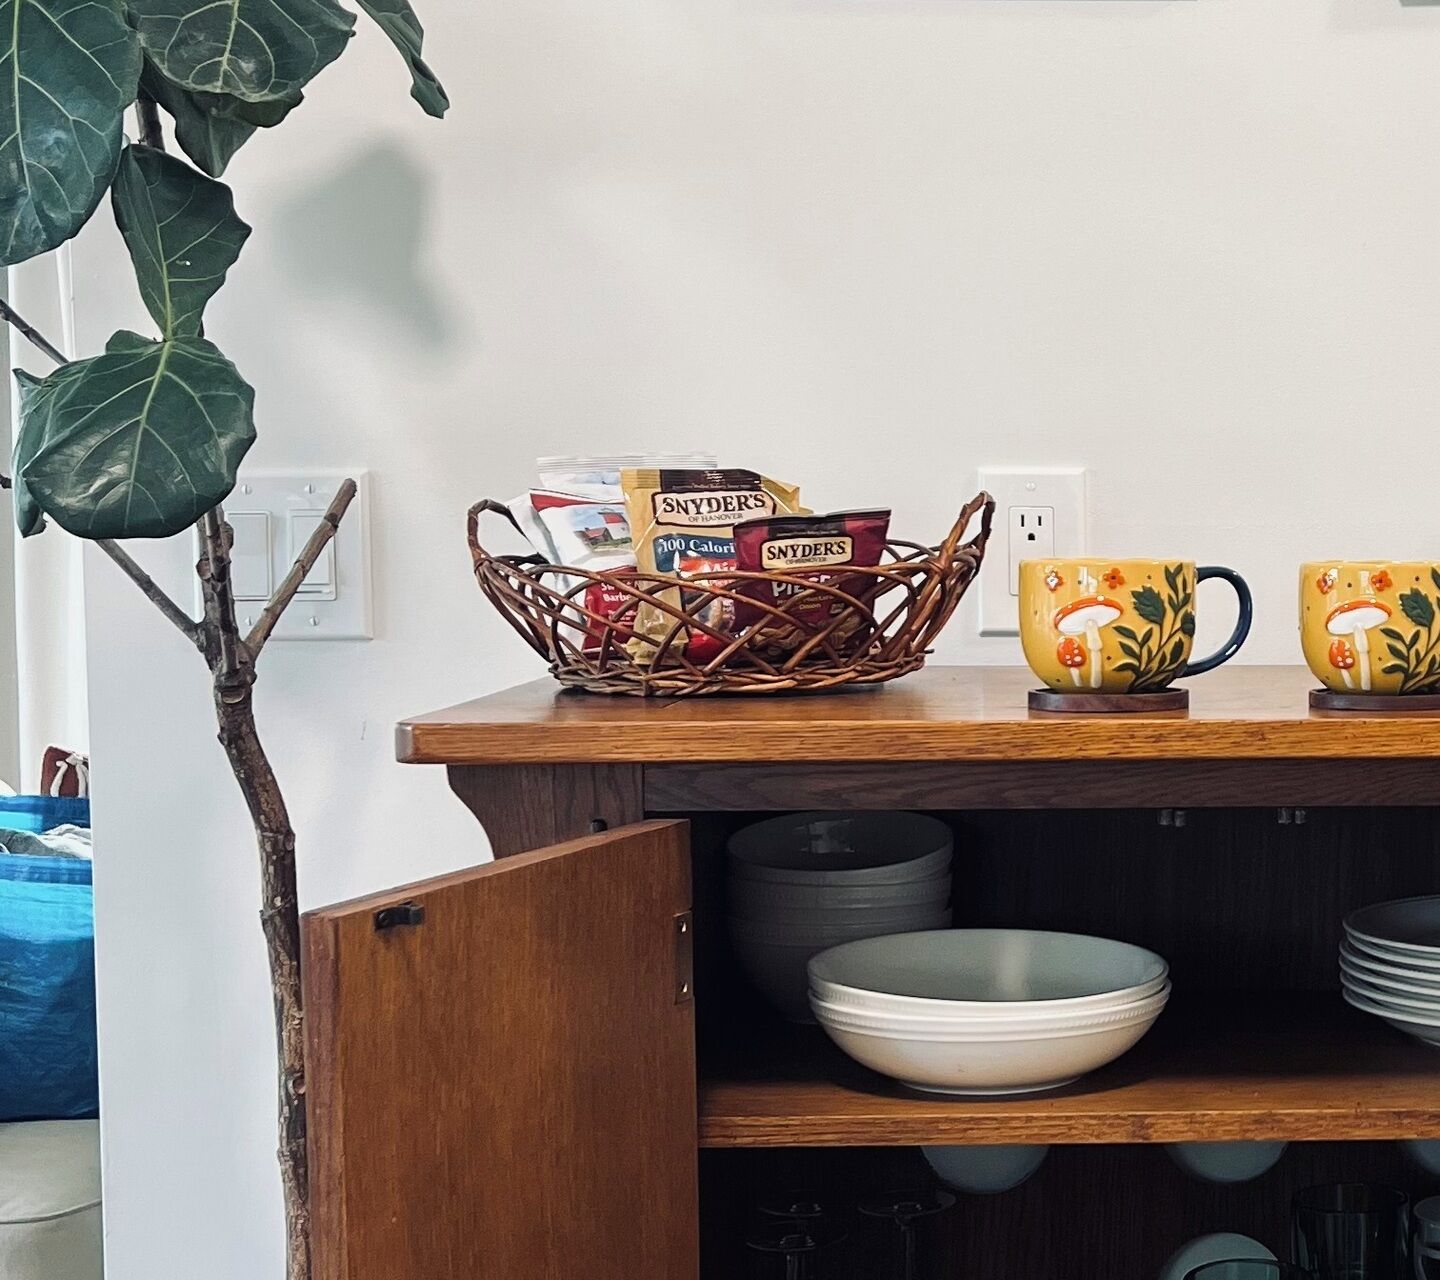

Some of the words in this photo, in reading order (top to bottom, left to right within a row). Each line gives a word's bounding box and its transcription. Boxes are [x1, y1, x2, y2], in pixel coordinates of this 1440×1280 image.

[663, 493, 766, 516] SNYDER'S
[687, 515, 699, 523] OF
[701, 513, 744, 522] HANOVER
[661, 538, 686, 553] 100
[689, 539, 737, 554] Calori
[766, 540, 847, 561] SNYDER'S
[602, 591, 631, 602] Barbe
